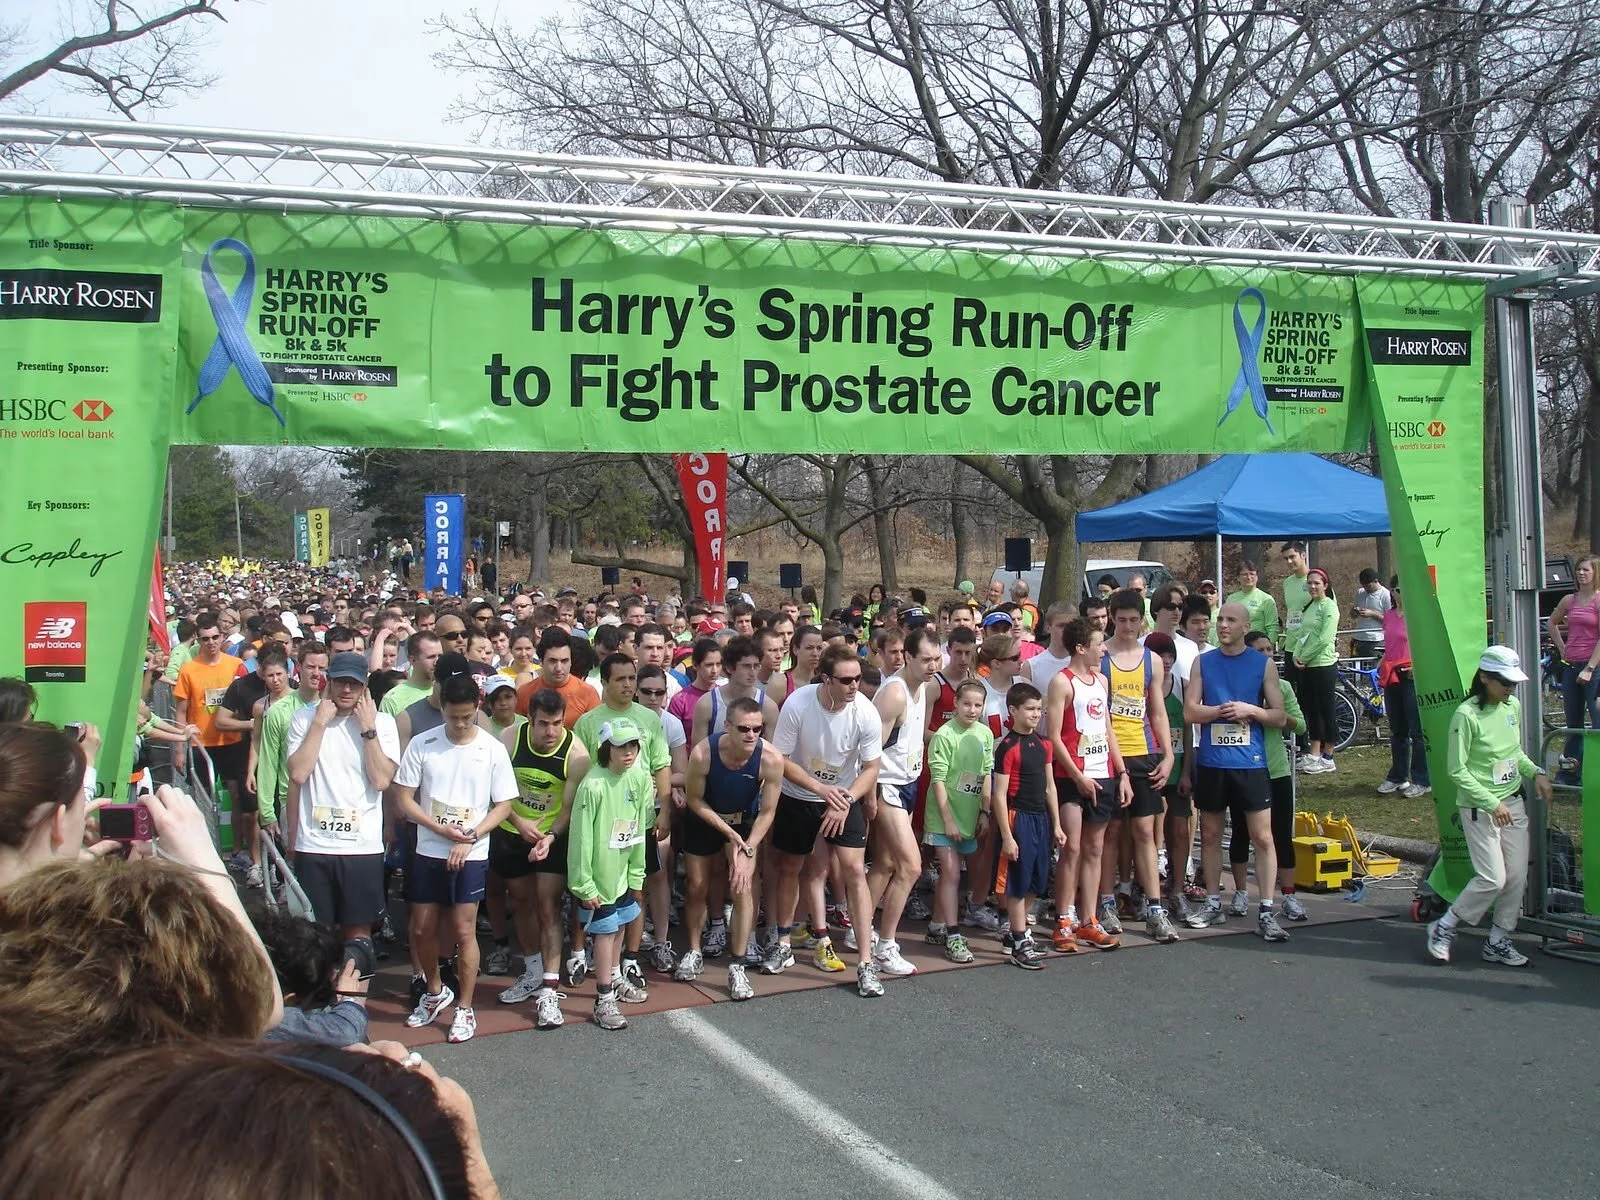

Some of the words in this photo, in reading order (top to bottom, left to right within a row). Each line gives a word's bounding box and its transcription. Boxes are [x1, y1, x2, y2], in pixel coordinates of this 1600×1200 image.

[29, 239, 50, 248] Title
[54, 240, 94, 251] Sponsor:
[266, 268, 389, 294] HARRY'S
[0, 281, 74, 306] HARRY
[76, 282, 155, 309] ROSEN
[261, 291, 368, 316] SPRING
[531, 277, 735, 350] Harry's
[756, 287, 934, 358] Spring
[952, 297, 1134, 352] Run-Off
[1270, 311, 1342, 330] HARRY'S
[259, 314, 381, 339] RUN-OFF
[1266, 328, 1330, 347] SPRING
[285, 338, 306, 351] 8k
[310, 339, 322, 351] &
[326, 339, 347, 352] 5k
[1387, 336, 1430, 355] HARRY
[1431, 337, 1467, 356] ROSEN
[273, 352, 299, 360] FIGHT
[300, 353, 345, 361] PROSTATE
[1263, 346, 1338, 365] RUN-OFF
[17, 362, 64, 374] Presenting
[68, 363, 109, 374] Sponsor:
[1277, 365, 1290, 375] 8k
[1293, 366, 1301, 375] &
[1304, 366, 1316, 376] 5k
[322, 369, 357, 380] HARRY
[357, 369, 390, 381] ROSEN
[484, 353, 551, 407] to
[569, 353, 719, 422] Fight
[743, 359, 971, 416] Prostate
[992, 366, 1161, 417] Cancer
[1300, 388, 1322, 398] HARRY
[1322, 389, 1341, 399] ROSEN
[323, 392, 351, 401] HSBC
[0, 399, 67, 421] HSBC
[0, 429, 17, 438] The
[59, 429, 84, 438] local
[88, 429, 114, 439] bank
[1388, 421, 1425, 438] HSBC
[28, 500, 41, 511] Key
[45, 500, 90, 511] Sponsors:
[1, 538, 122, 577] Coppley
[47, 640, 82, 649] balance
[1425, 688, 1458, 706] MAIL
[1117, 706, 1142, 717] 3149
[1217, 736, 1243, 744] 3054
[1085, 744, 1107, 755] 3881
[814, 770, 836, 781] 452
[964, 784, 982, 795] 340
[320, 820, 351, 832] 3128
